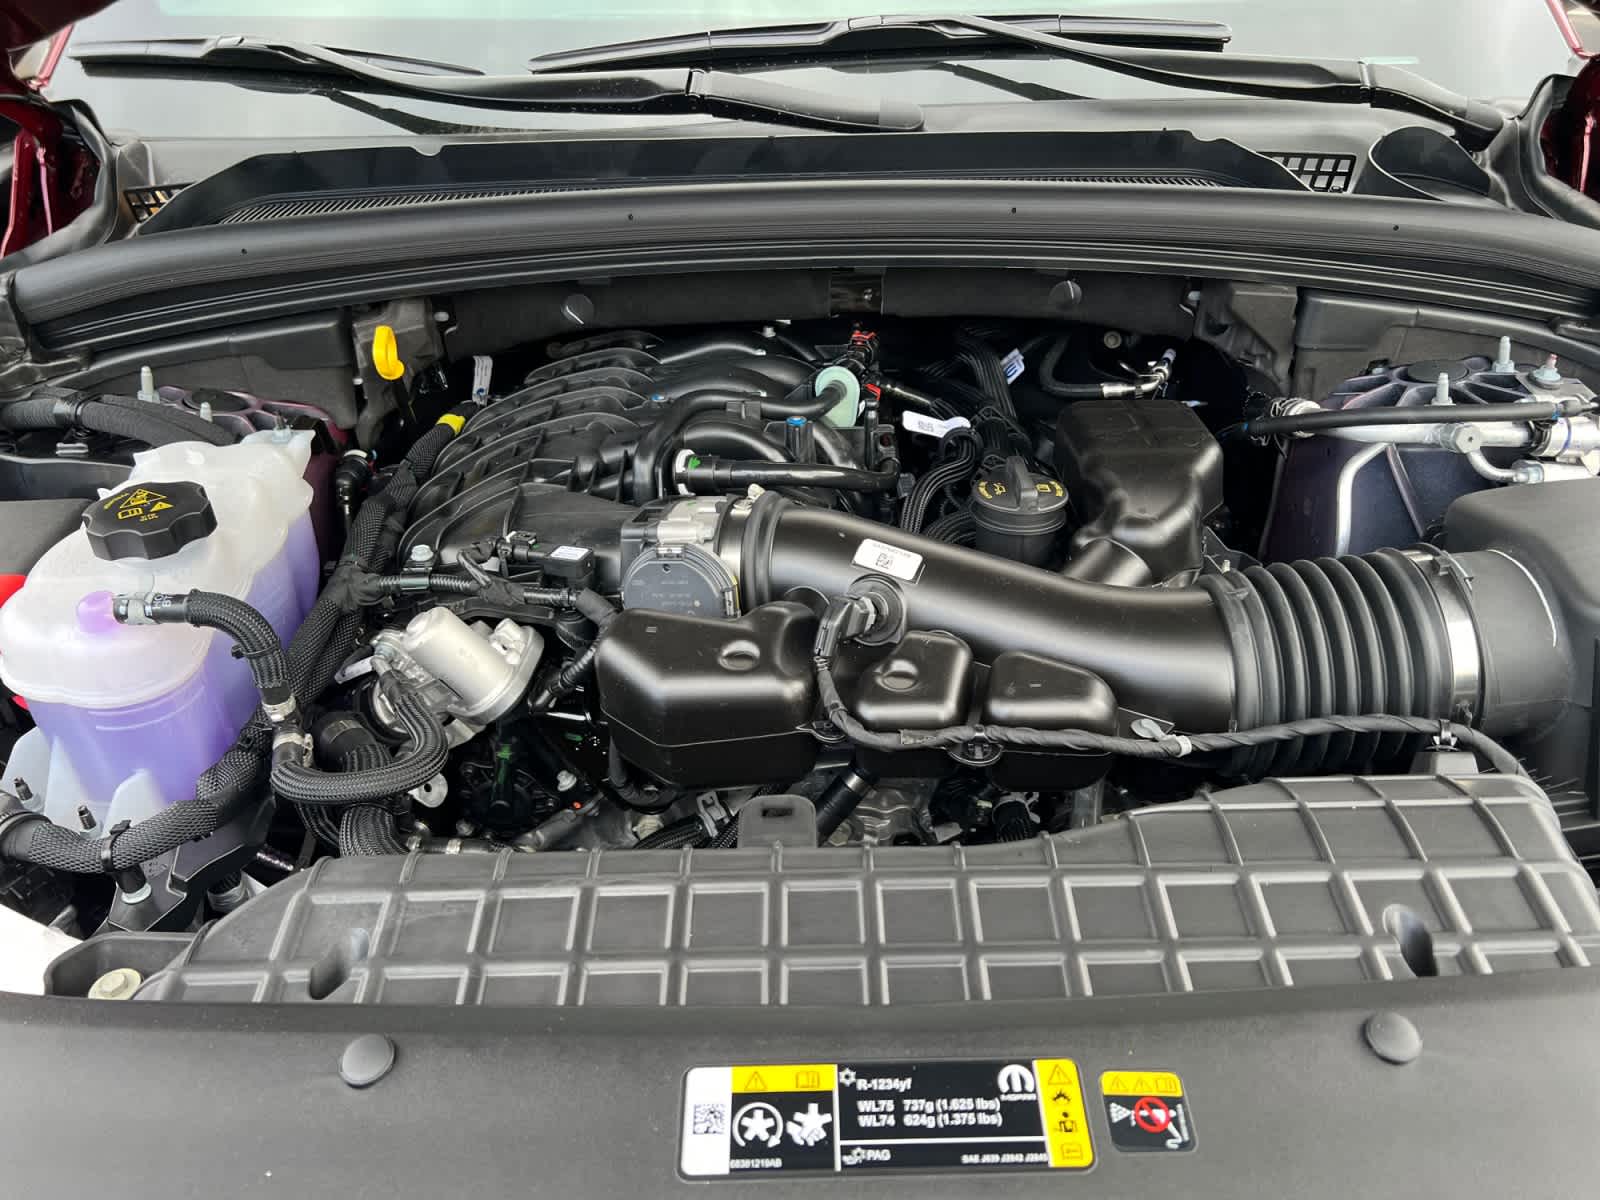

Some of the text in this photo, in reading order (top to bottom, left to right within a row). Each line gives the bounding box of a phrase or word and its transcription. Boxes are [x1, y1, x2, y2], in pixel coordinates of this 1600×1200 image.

[856, 1077, 912, 1093] R-1234yf
[857, 1097, 1001, 1114] WL75 737g (1.625 lbs)
[857, 1111, 1003, 1129] WL74 624g (1.375 lbs)
[866, 1148, 892, 1161] PAG
